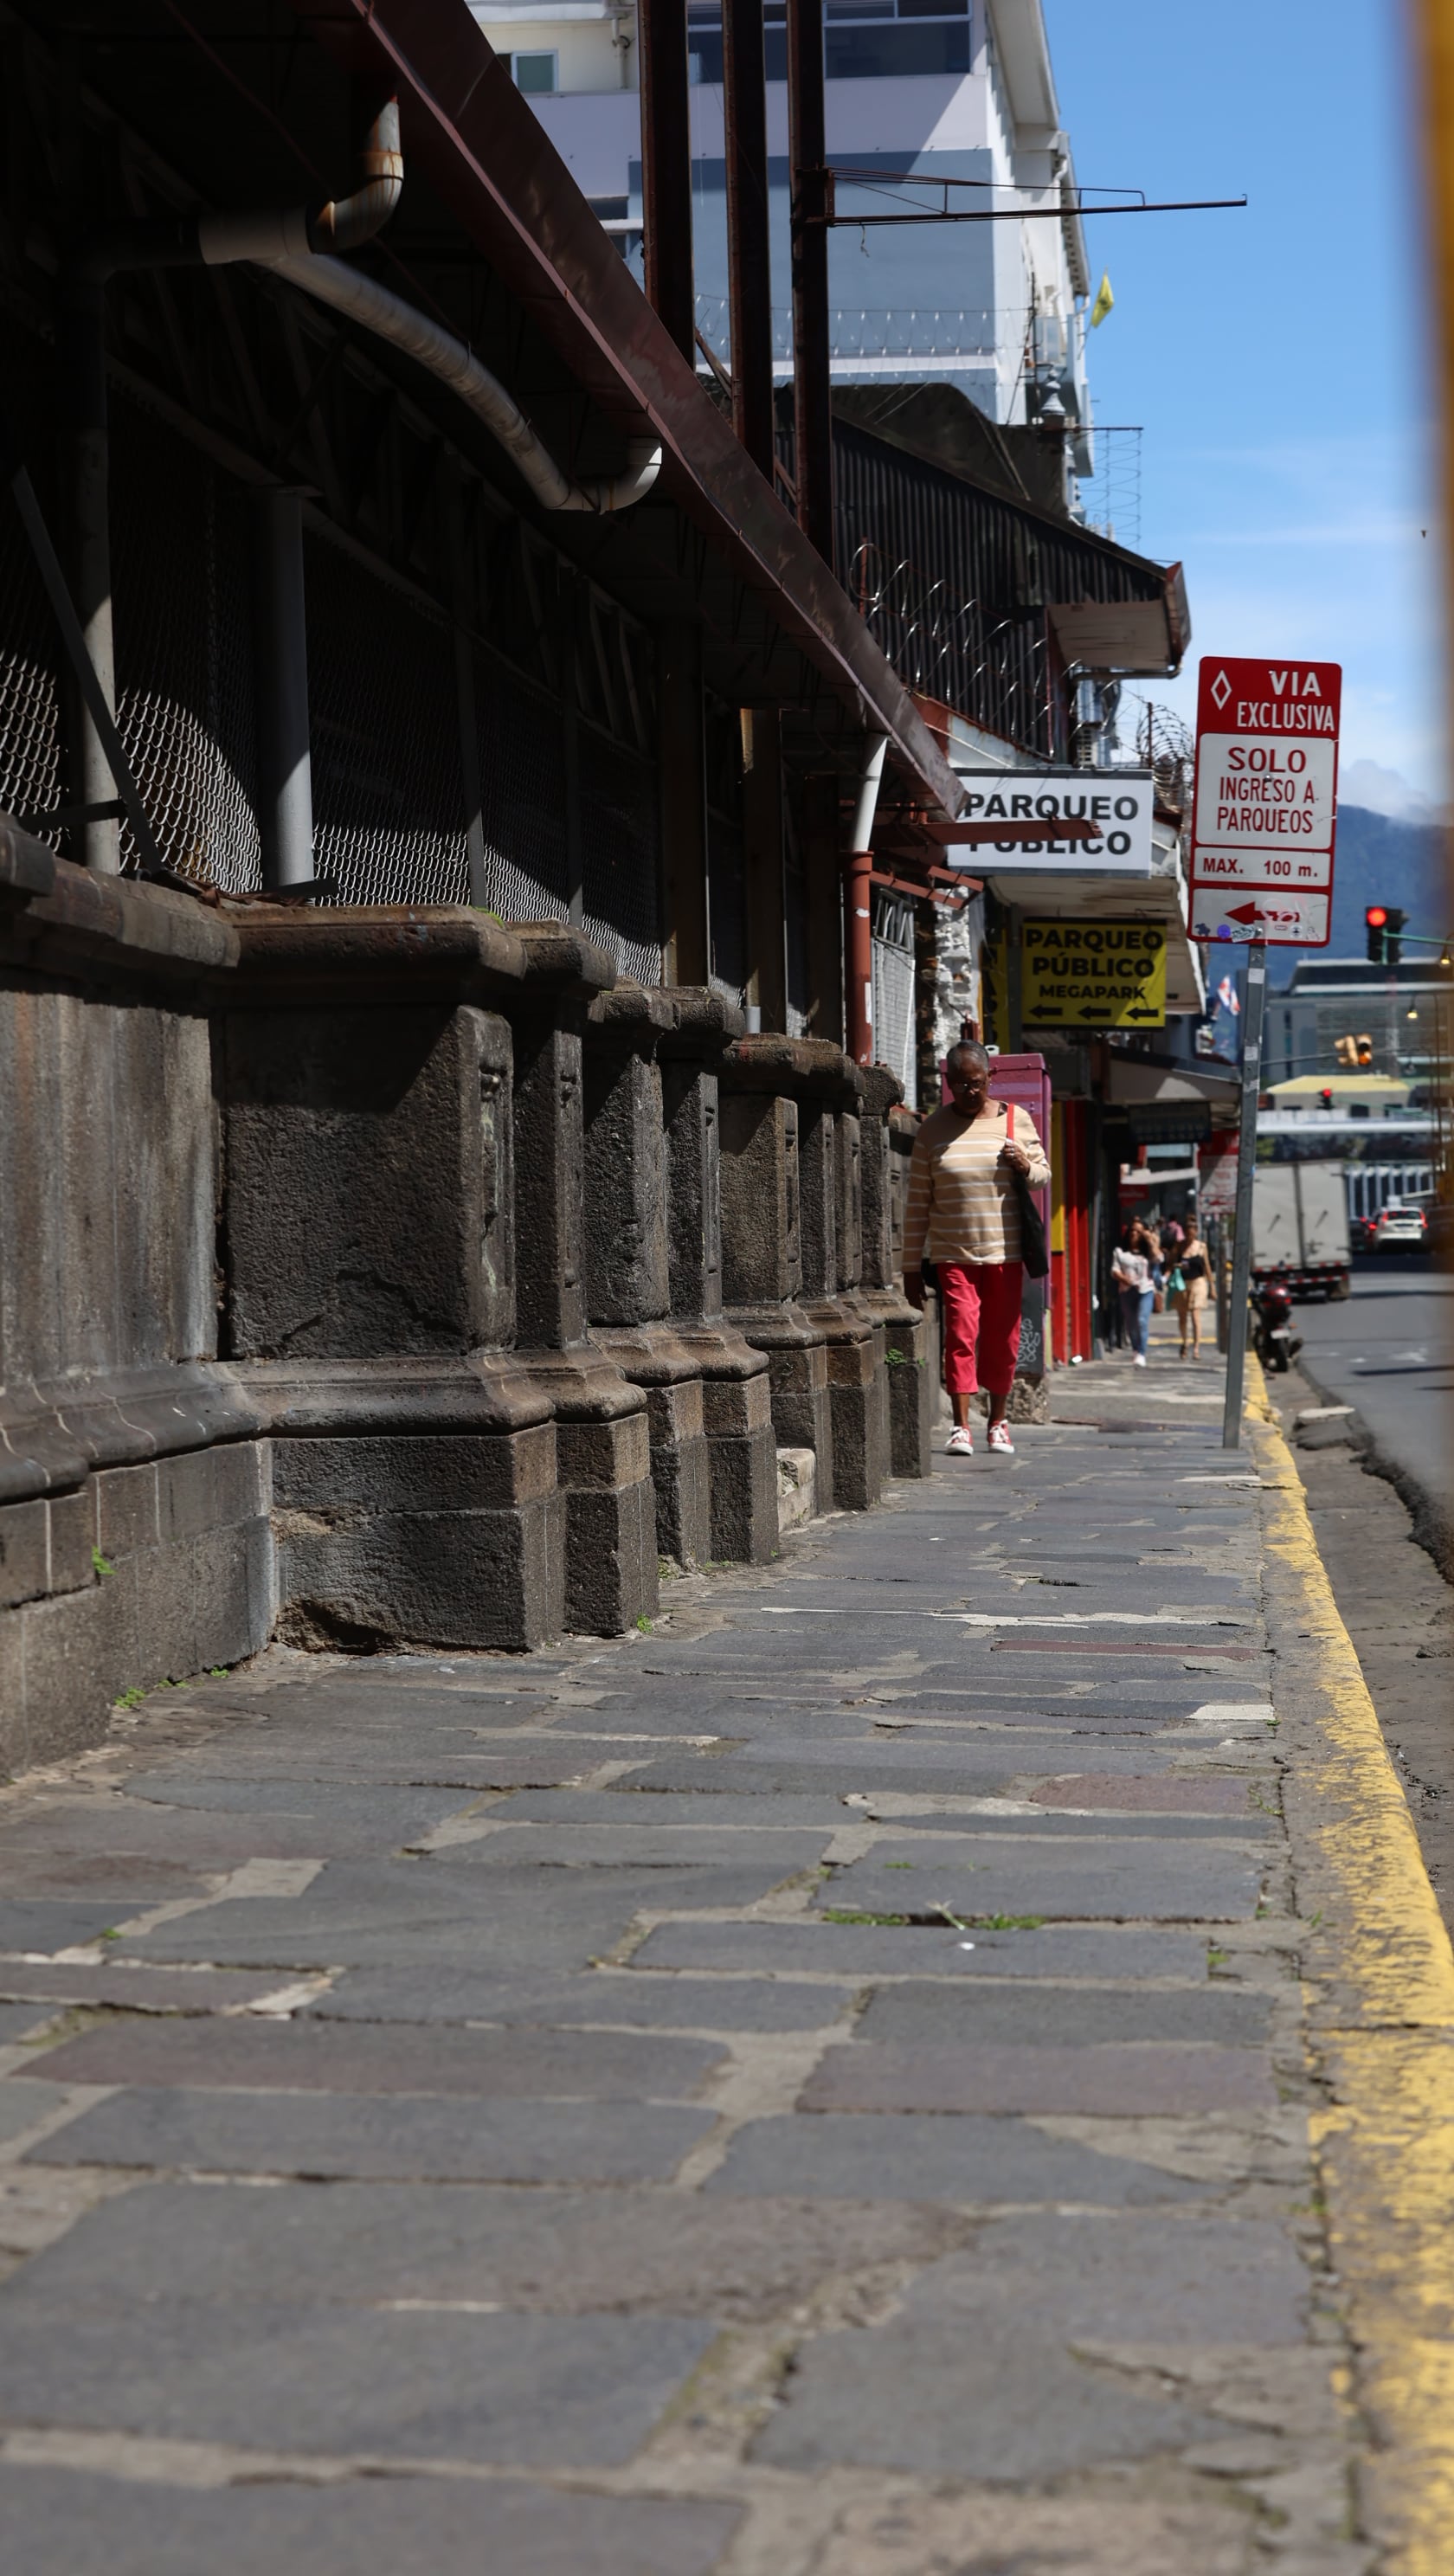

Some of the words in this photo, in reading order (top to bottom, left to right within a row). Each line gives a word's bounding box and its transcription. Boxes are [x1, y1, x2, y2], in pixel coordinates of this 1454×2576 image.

[1268, 670, 1322, 697] VIA
[1237, 701, 1335, 731] EXCLUSIVA
[1227, 746, 1307, 773] SOLO
[1219, 776, 1295, 802] INGRESO
[1303, 780, 1315, 803] A
[963, 794, 1139, 821] PARQUEO
[1217, 806, 1314, 834] PARQUEOS
[1202, 857, 1244, 873] MAX.
[1264, 860, 1291, 876] 100
[1298, 866, 1317, 877] m.
[1026, 929, 1163, 952] PARQUEO
[1033, 951, 1155, 977] PÚBLICO
[1039, 984, 1146, 999] MEGAPARK
